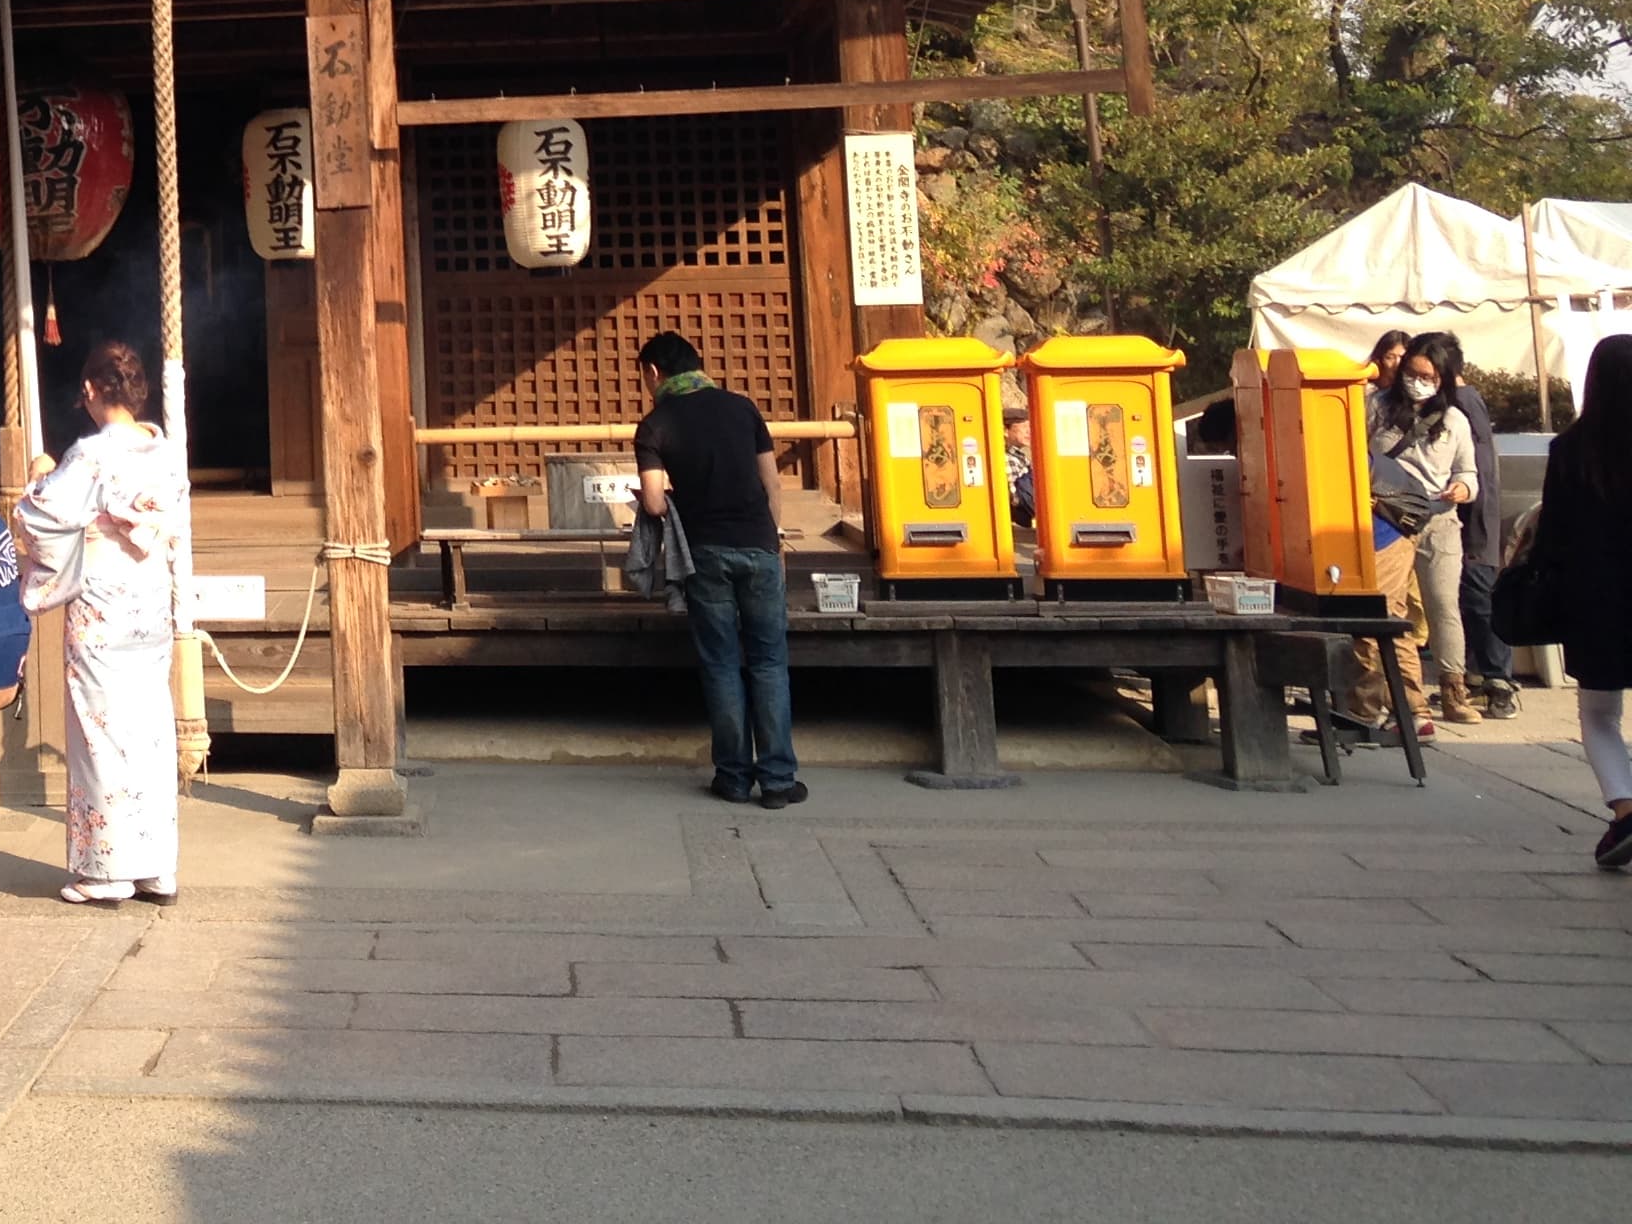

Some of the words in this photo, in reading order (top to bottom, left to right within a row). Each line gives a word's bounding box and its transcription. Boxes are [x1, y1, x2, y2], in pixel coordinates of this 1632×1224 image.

[265, 121, 306, 252] 石不動明王
[534, 126, 577, 257] 石不動明王
[897, 164, 916, 276] 金閣寺のお不動さん
